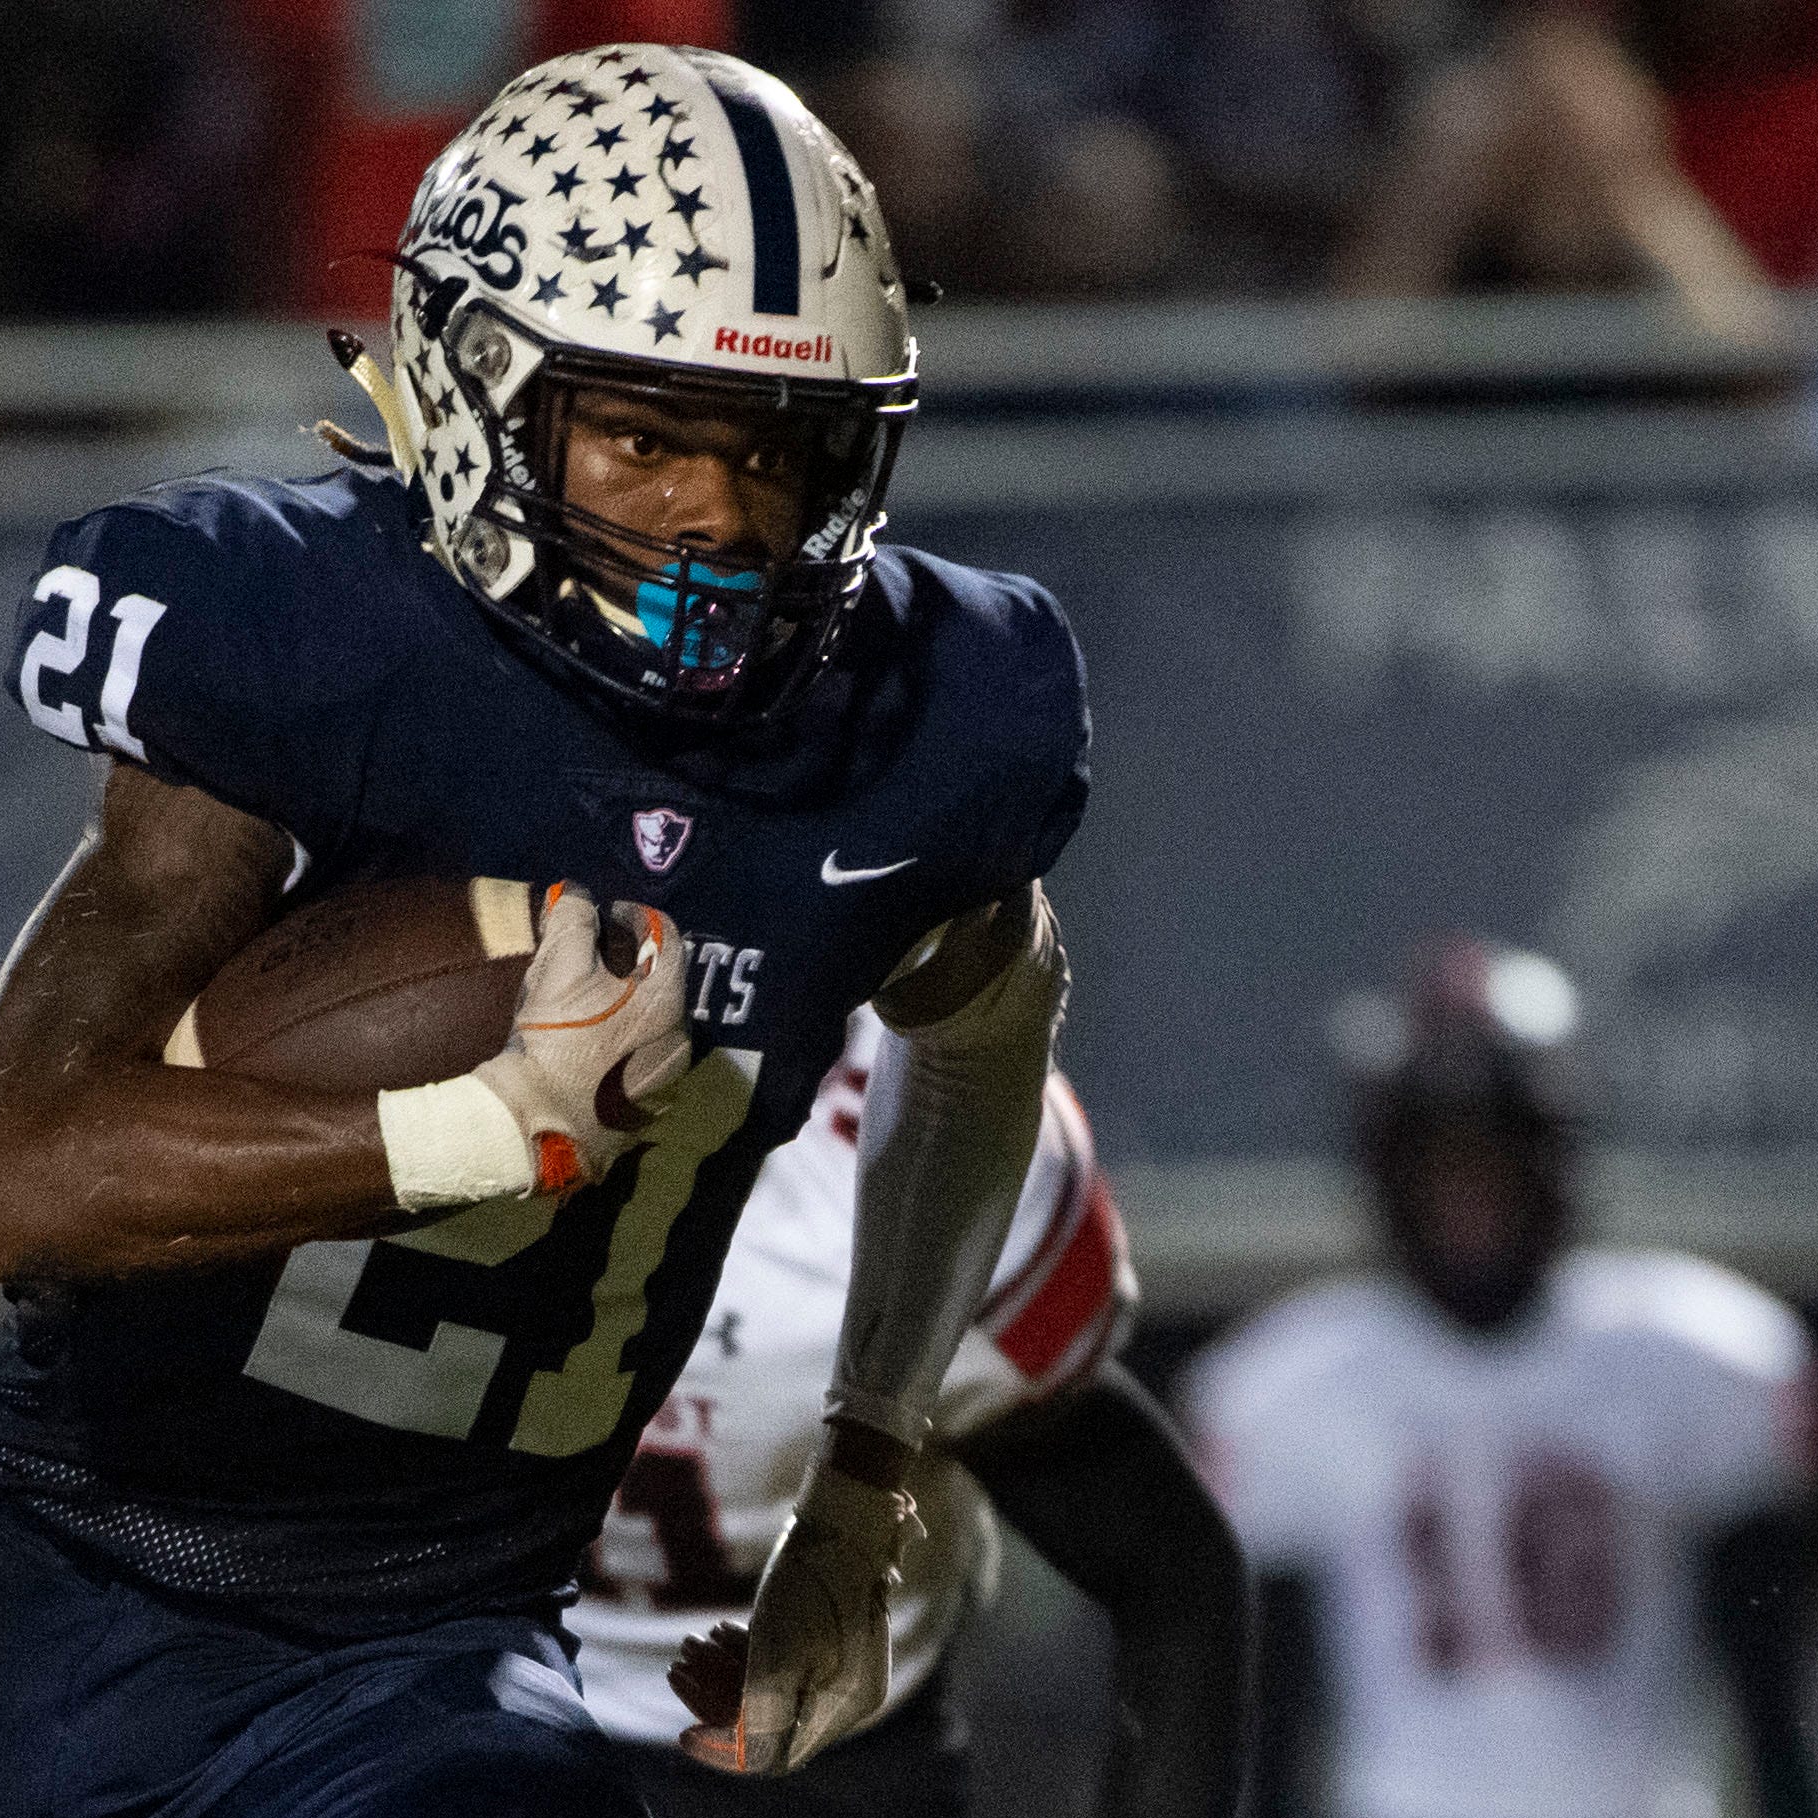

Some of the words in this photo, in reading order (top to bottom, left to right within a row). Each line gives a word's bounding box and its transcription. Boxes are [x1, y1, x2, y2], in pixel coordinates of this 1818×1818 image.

[714, 326, 834, 363] Riddell
[800, 486, 867, 561] Ridde
[19, 563, 168, 765] 21
[243, 1047, 762, 1458] 21
